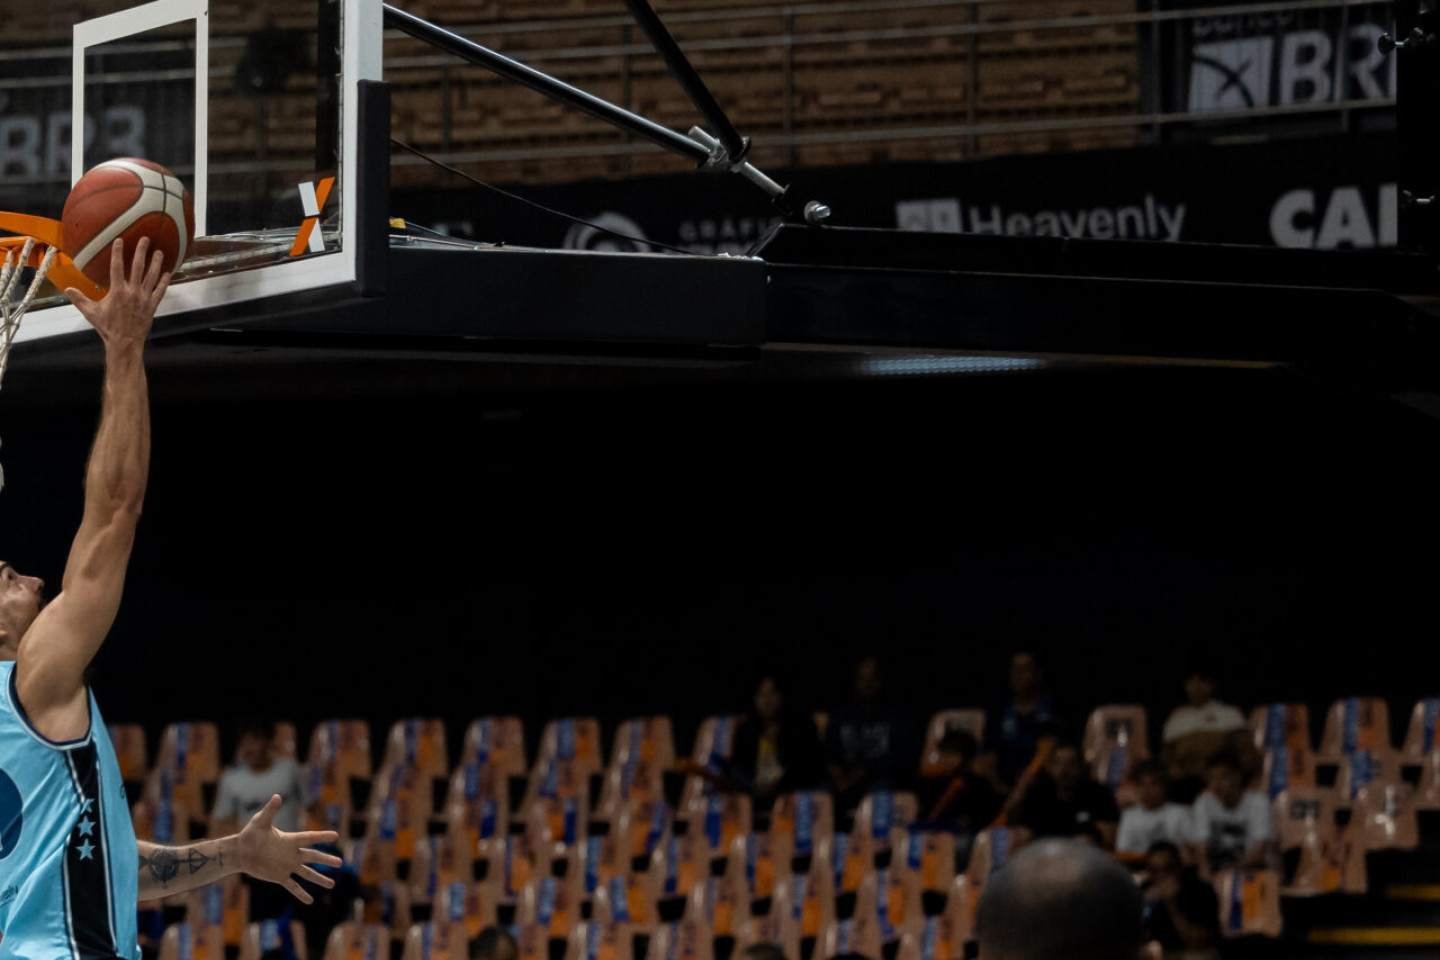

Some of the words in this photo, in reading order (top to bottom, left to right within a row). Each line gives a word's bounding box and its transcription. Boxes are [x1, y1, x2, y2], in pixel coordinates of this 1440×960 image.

[1280, 23, 1398, 103] BR
[969, 193, 1187, 240] Heavenly
[1268, 181, 1398, 251] CAI
